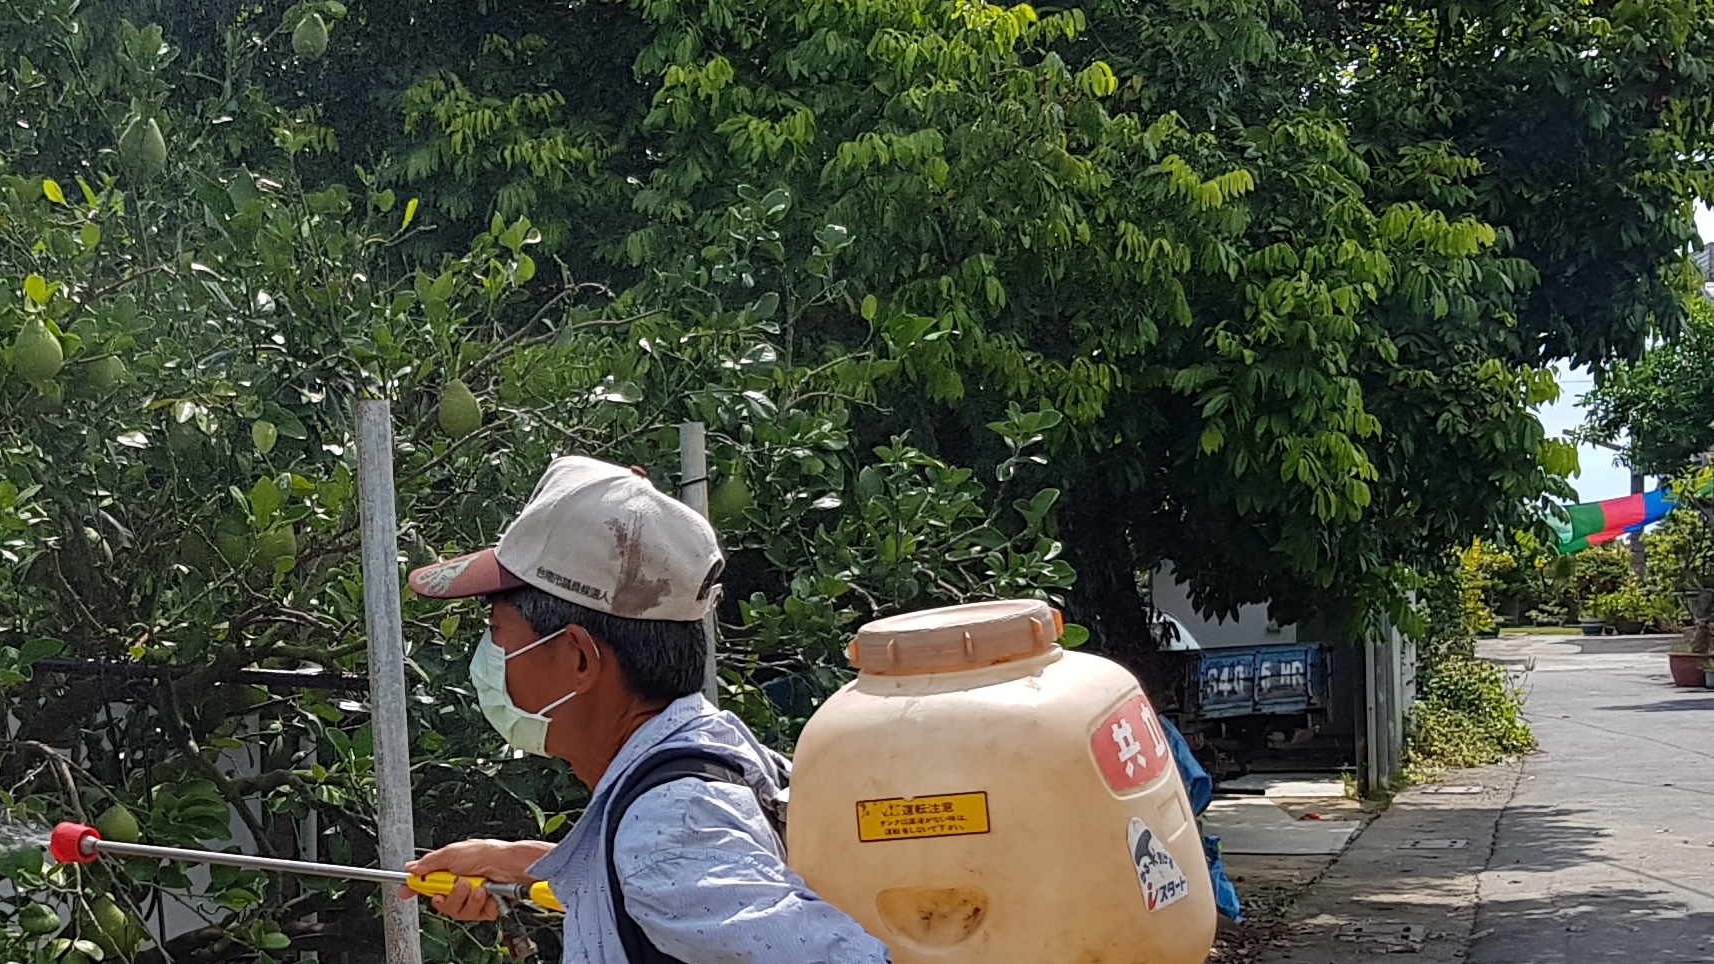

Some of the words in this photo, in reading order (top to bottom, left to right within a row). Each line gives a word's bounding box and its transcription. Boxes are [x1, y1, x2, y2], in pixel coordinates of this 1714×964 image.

[536, 566, 610, 604] 台南市議員候選人
[1110, 702, 1166, 778] 共立
[901, 801, 954, 816] 運転注意
